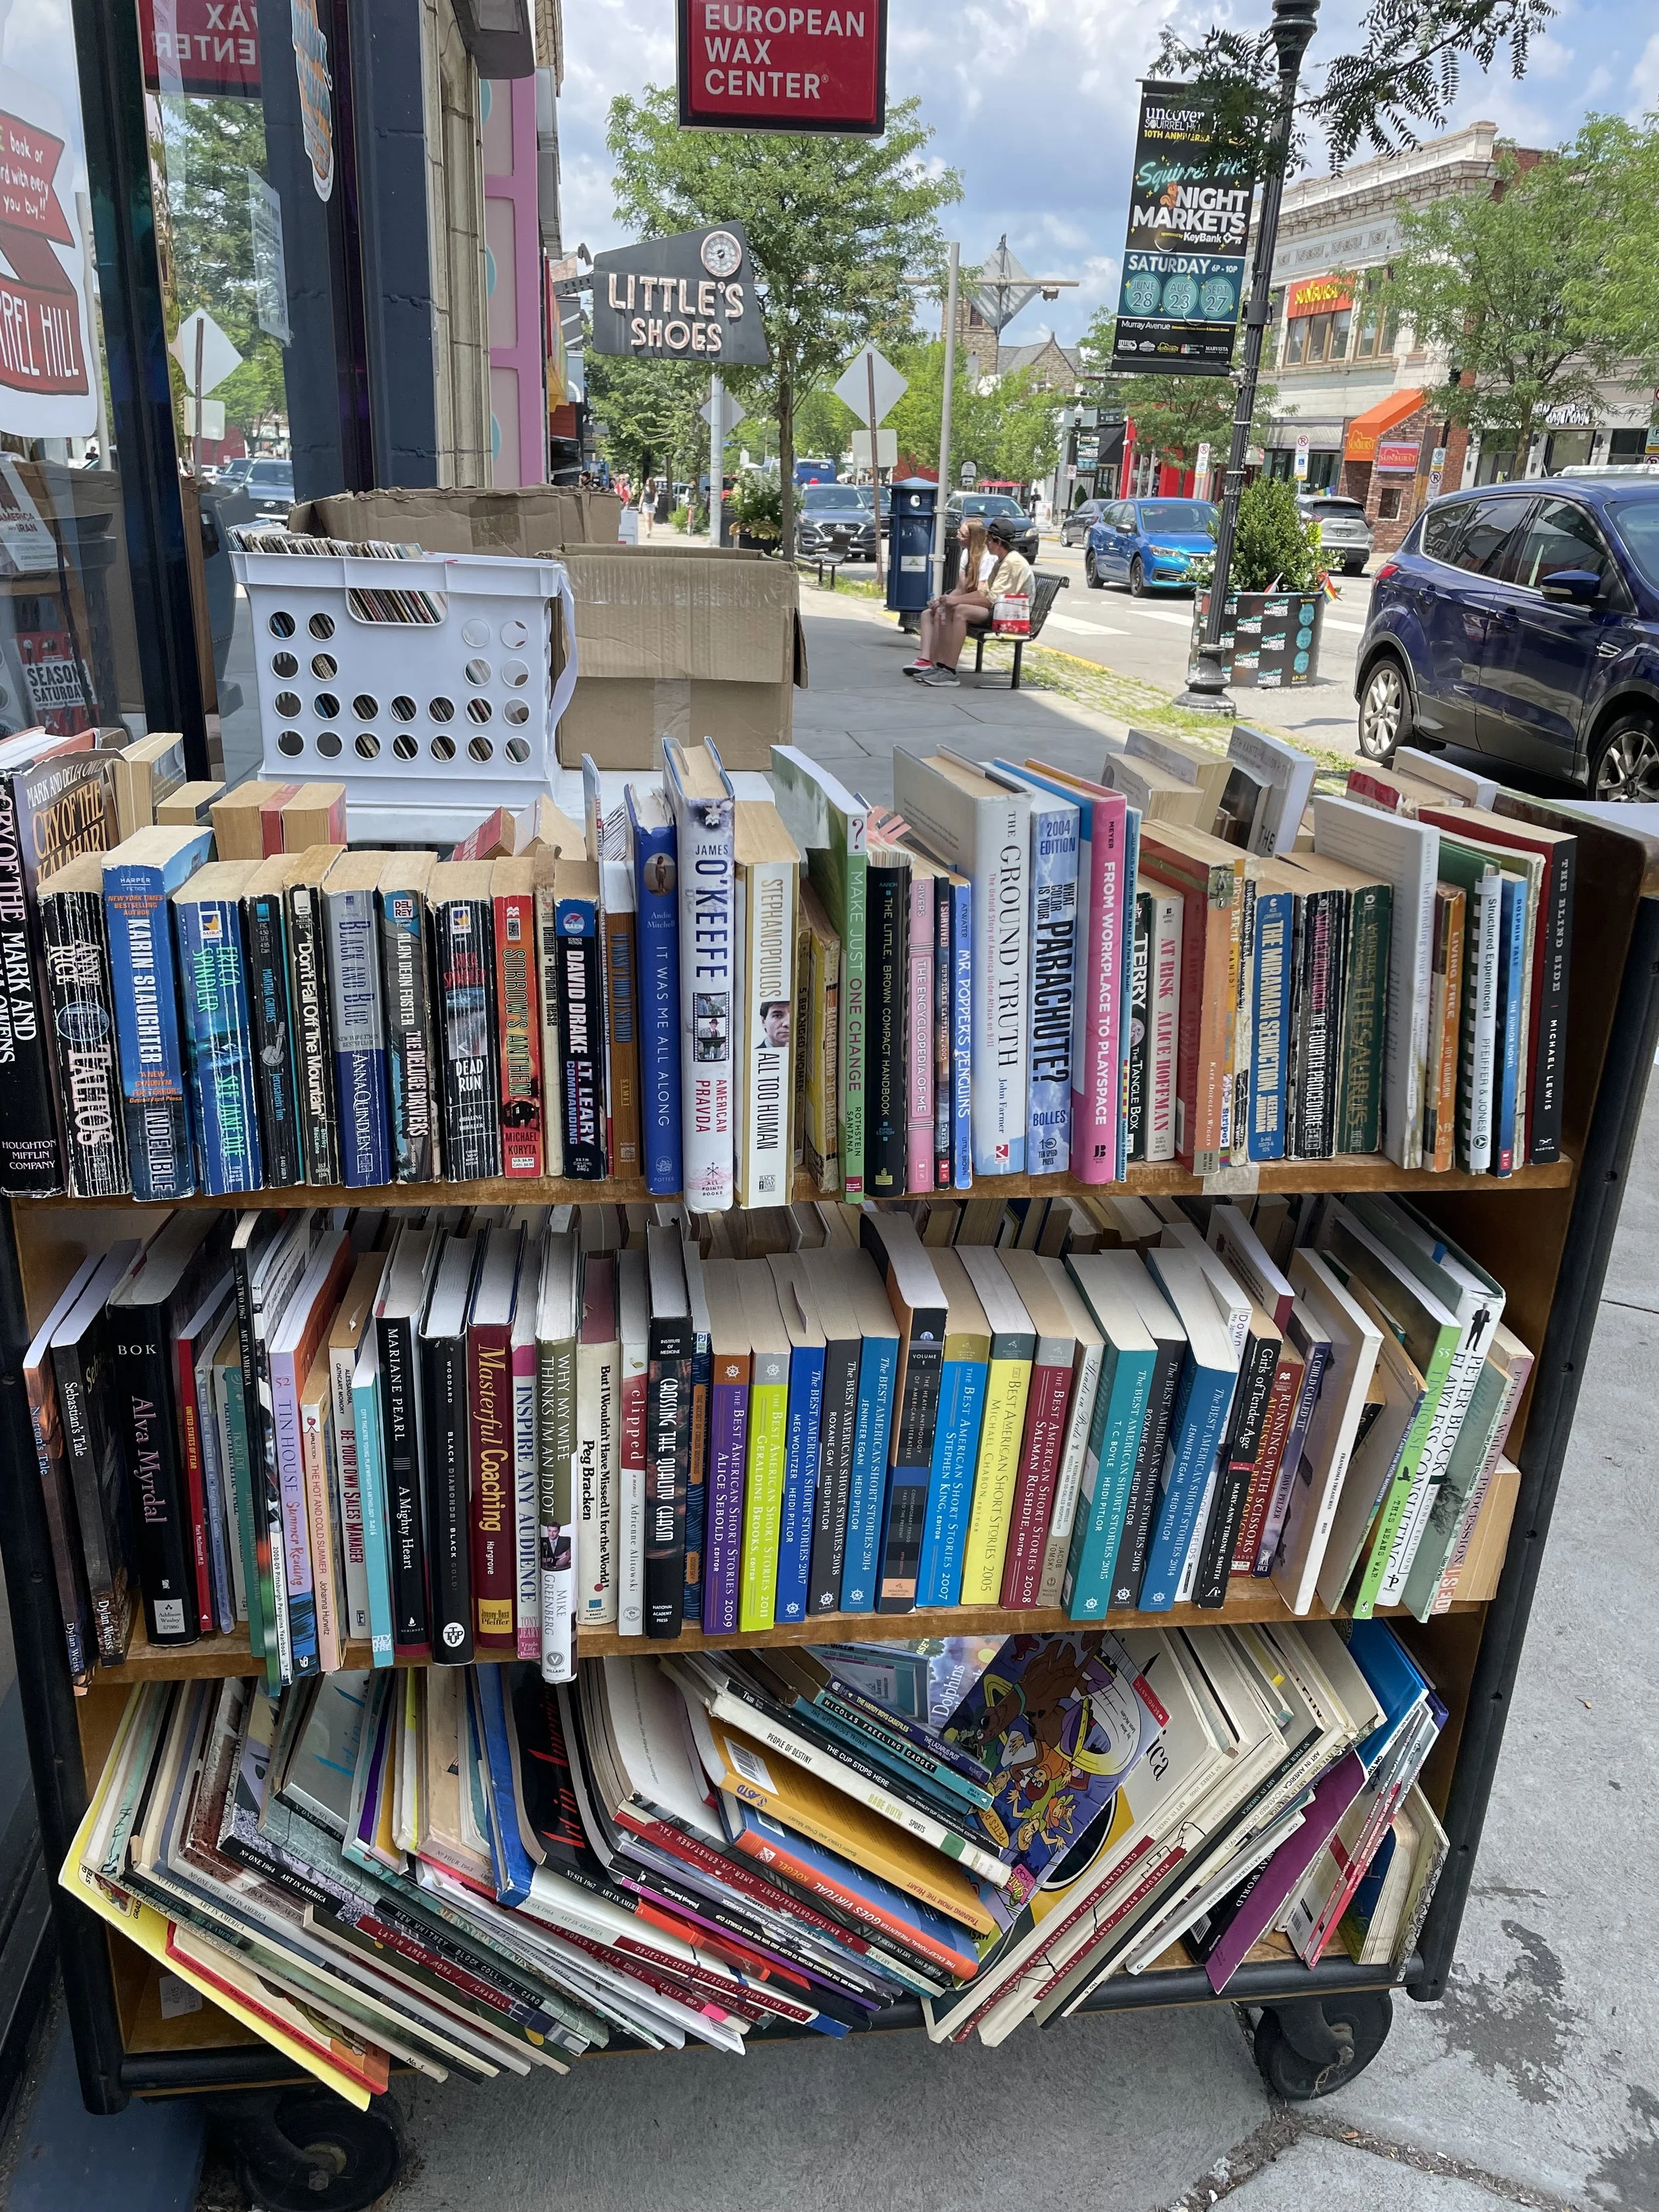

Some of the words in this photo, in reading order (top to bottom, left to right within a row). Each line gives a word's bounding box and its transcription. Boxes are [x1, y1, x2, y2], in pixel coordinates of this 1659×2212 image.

[705, 4, 865, 37] EUROPEAN
[705, 37, 772, 65] WAX
[1145, 119, 1185, 131] SQUIRREL
[1146, 108, 1204, 123] uncover
[10, 130, 31, 160] book
[35, 149, 44, 164] or
[11, 167, 28, 188] with
[30, 171, 48, 200] every
[1176, 186, 1249, 212] NIGHT
[1133, 205, 1246, 234] MARKETS
[1183, 232, 1222, 244] KeyBank
[1128, 255, 1211, 274] SATURDAY
[609, 273, 745, 318] LITTLE'S
[1131, 281, 1156, 291] JUNE
[1132, 292, 1153, 308] 28
[1169, 282, 1190, 293] AUG
[1169, 294, 1190, 310] 23
[1205, 296, 1228, 312] 27
[1206, 285, 1229, 294] SEPT
[39, 303, 79, 378] HILL
[630, 317, 722, 352] SHOES
[1121, 321, 1145, 331] Murray
[1380, 453, 1416, 463] SUNBURST
[1040, 838, 1076, 855] EDITION
[1046, 822, 1071, 838] 2004
[695, 844, 729, 856] JAMES
[1104, 861, 1116, 909] FROM
[1559, 858, 1569, 893] THE
[848, 871, 864, 925] MAKE
[998, 845, 1022, 966] GROUND
[695, 859, 729, 979] O'KEEFE
[1556, 900, 1567, 946] BLIND
[127, 919, 155, 969] KARIN
[338, 920, 371, 962] BLACK
[397, 932, 411, 956] ALAN
[760, 879, 782, 998] STEPHANOPOULOS
[848, 929, 863, 973] JUST
[1, 932, 31, 991] MARK
[345, 966, 366, 988] AND
[399, 959, 413, 985] DEAN
[566, 950, 585, 999] DAVID
[958, 950, 971, 974] MR.
[1098, 914, 1114, 1011] WORKPLACE
[1552, 956, 1563, 992] SIDE
[400, 986, 414, 1026] FOSTER
[503, 949, 529, 1029] SORROW'S
[848, 977, 863, 1014] ONE
[1033, 919, 1075, 1082] PARACHUTE?
[10, 999, 36, 1041] AND
[133, 975, 163, 1064] SLAUGHTER
[345, 992, 375, 1027] BLUE
[956, 982, 972, 1046] POPPER'S
[997, 972, 1020, 1069] TRUTH
[1097, 1016, 1111, 1033] TO
[568, 1003, 587, 1054] DRAKE
[1546, 1019, 1557, 1071] MICHAEL
[456, 1060, 484, 1076] DEAD
[506, 1034, 532, 1096] ANTHEM
[576, 1061, 593, 1081] LT.
[758, 1052, 780, 1075] ALL
[847, 1021, 861, 1092] CHANGE
[459, 1075, 482, 1091] RUN
[757, 1077, 779, 1099] TOO
[956, 1049, 972, 1119] PENGUINS
[1094, 1037, 1110, 1126] PLAYSPACE
[1544, 1074, 1554, 1111] LEWIS
[566, 1061, 578, 1145] COMMANDING
[579, 1088, 595, 1146] LEARY
[695, 1080, 710, 1134] PRAVDA
[716, 1080, 727, 1133] AMERICAN
[1033, 1110, 1066, 1127] BOLLES
[2, 1139, 56, 1149] HOUGHTON
[505, 1132, 539, 1143] MICHAEL
[756, 1102, 779, 1151] HUMAN
[9, 1160, 55, 1171] COMPANY
[13, 1151, 50, 1159] MIFFLIN
[144, 1108, 175, 1191] INDELIBLE
[508, 1143, 537, 1155] KORYTA
[117, 1344, 157, 1355] BOK
[388, 1328, 403, 1393] MARIANE
[541, 1355, 555, 1417] THINKS
[557, 1353, 570, 1384] WHY
[1458, 1355, 1484, 1411] PETER
[66, 1381, 83, 1436] Sebastian's
[472, 1343, 506, 1444] Masterful
[557, 1391, 570, 1416] MY
[660, 1378, 678, 1426] CROSSING
[132, 1395, 157, 1445] Alva
[278, 1399, 292, 1426] TIN
[392, 1395, 405, 1442] PEARL
[516, 1385, 533, 1461] INSPIRE
[625, 1389, 646, 1461] clipped
[74, 1437, 84, 1456] Tale
[543, 1422, 554, 1442] I'M
[557, 1425, 570, 1461] WIFE
[658, 1430, 676, 1453] THE
[1029, 1421, 1047, 1471] SALMAN
[1434, 1414, 1467, 1475] BLOCK
[280, 1432, 298, 1493] HOUSE
[543, 1447, 553, 1468] AN
[579, 1439, 595, 1465] Peg
[790, 1436, 800, 1479] WOLITZER
[940, 1432, 956, 1480] STEPHEN
[137, 1449, 168, 1524] Myrdal
[478, 1447, 509, 1532] Coaching
[518, 1465, 535, 1507] ANY
[542, 1474, 555, 1517] IDIOT
[583, 1467, 595, 1520] Bracken
[657, 1455, 676, 1501] QUALITY
[397, 1497, 411, 1531] Mighty
[936, 1483, 951, 1514] KING,
[1017, 1475, 1035, 1532] RUSHDIE,
[285, 1501, 300, 1546] Summer
[656, 1505, 674, 1542] CHASM
[289, 1547, 303, 1587] Reading
[401, 1534, 413, 1570] Heart
[486, 1540, 495, 1576] Hargrove
[518, 1511, 536, 1603] AUDIENCE
[930, 1662, 966, 1718] Dolphins
[766, 1733, 784, 1747] PEOPLE
[784, 1741, 792, 1751] OF
[792, 1747, 813, 1765] DESTINY
[824, 1700, 859, 1724] NICOLAS
[862, 1724, 901, 1750] FREELING
[906, 1751, 935, 1771] GADGET
[826, 1744, 839, 1756] THE
[838, 1751, 853, 1763] CUP
[853, 1757, 873, 1777] STOPS
[873, 1773, 889, 1788] HERE
[867, 1793, 886, 1809] BABE
[885, 1805, 903, 1820] RUTH
[908, 1819, 926, 1833] SPORTS
[1101, 1852, 1137, 1889] CLEVELAND
[1139, 1864, 1170, 1894] MUSEUMS
[779, 1860, 809, 1883] KOEGEL
[812, 1882, 854, 1911] VIRTUAL
[852, 1906, 883, 1927] GOES
[377, 1928, 404, 1946] LATIN
[396, 1911, 411, 1925] NEW
[413, 1923, 449, 1947] WHITNEY
[455, 1949, 478, 1966] BLOCK
